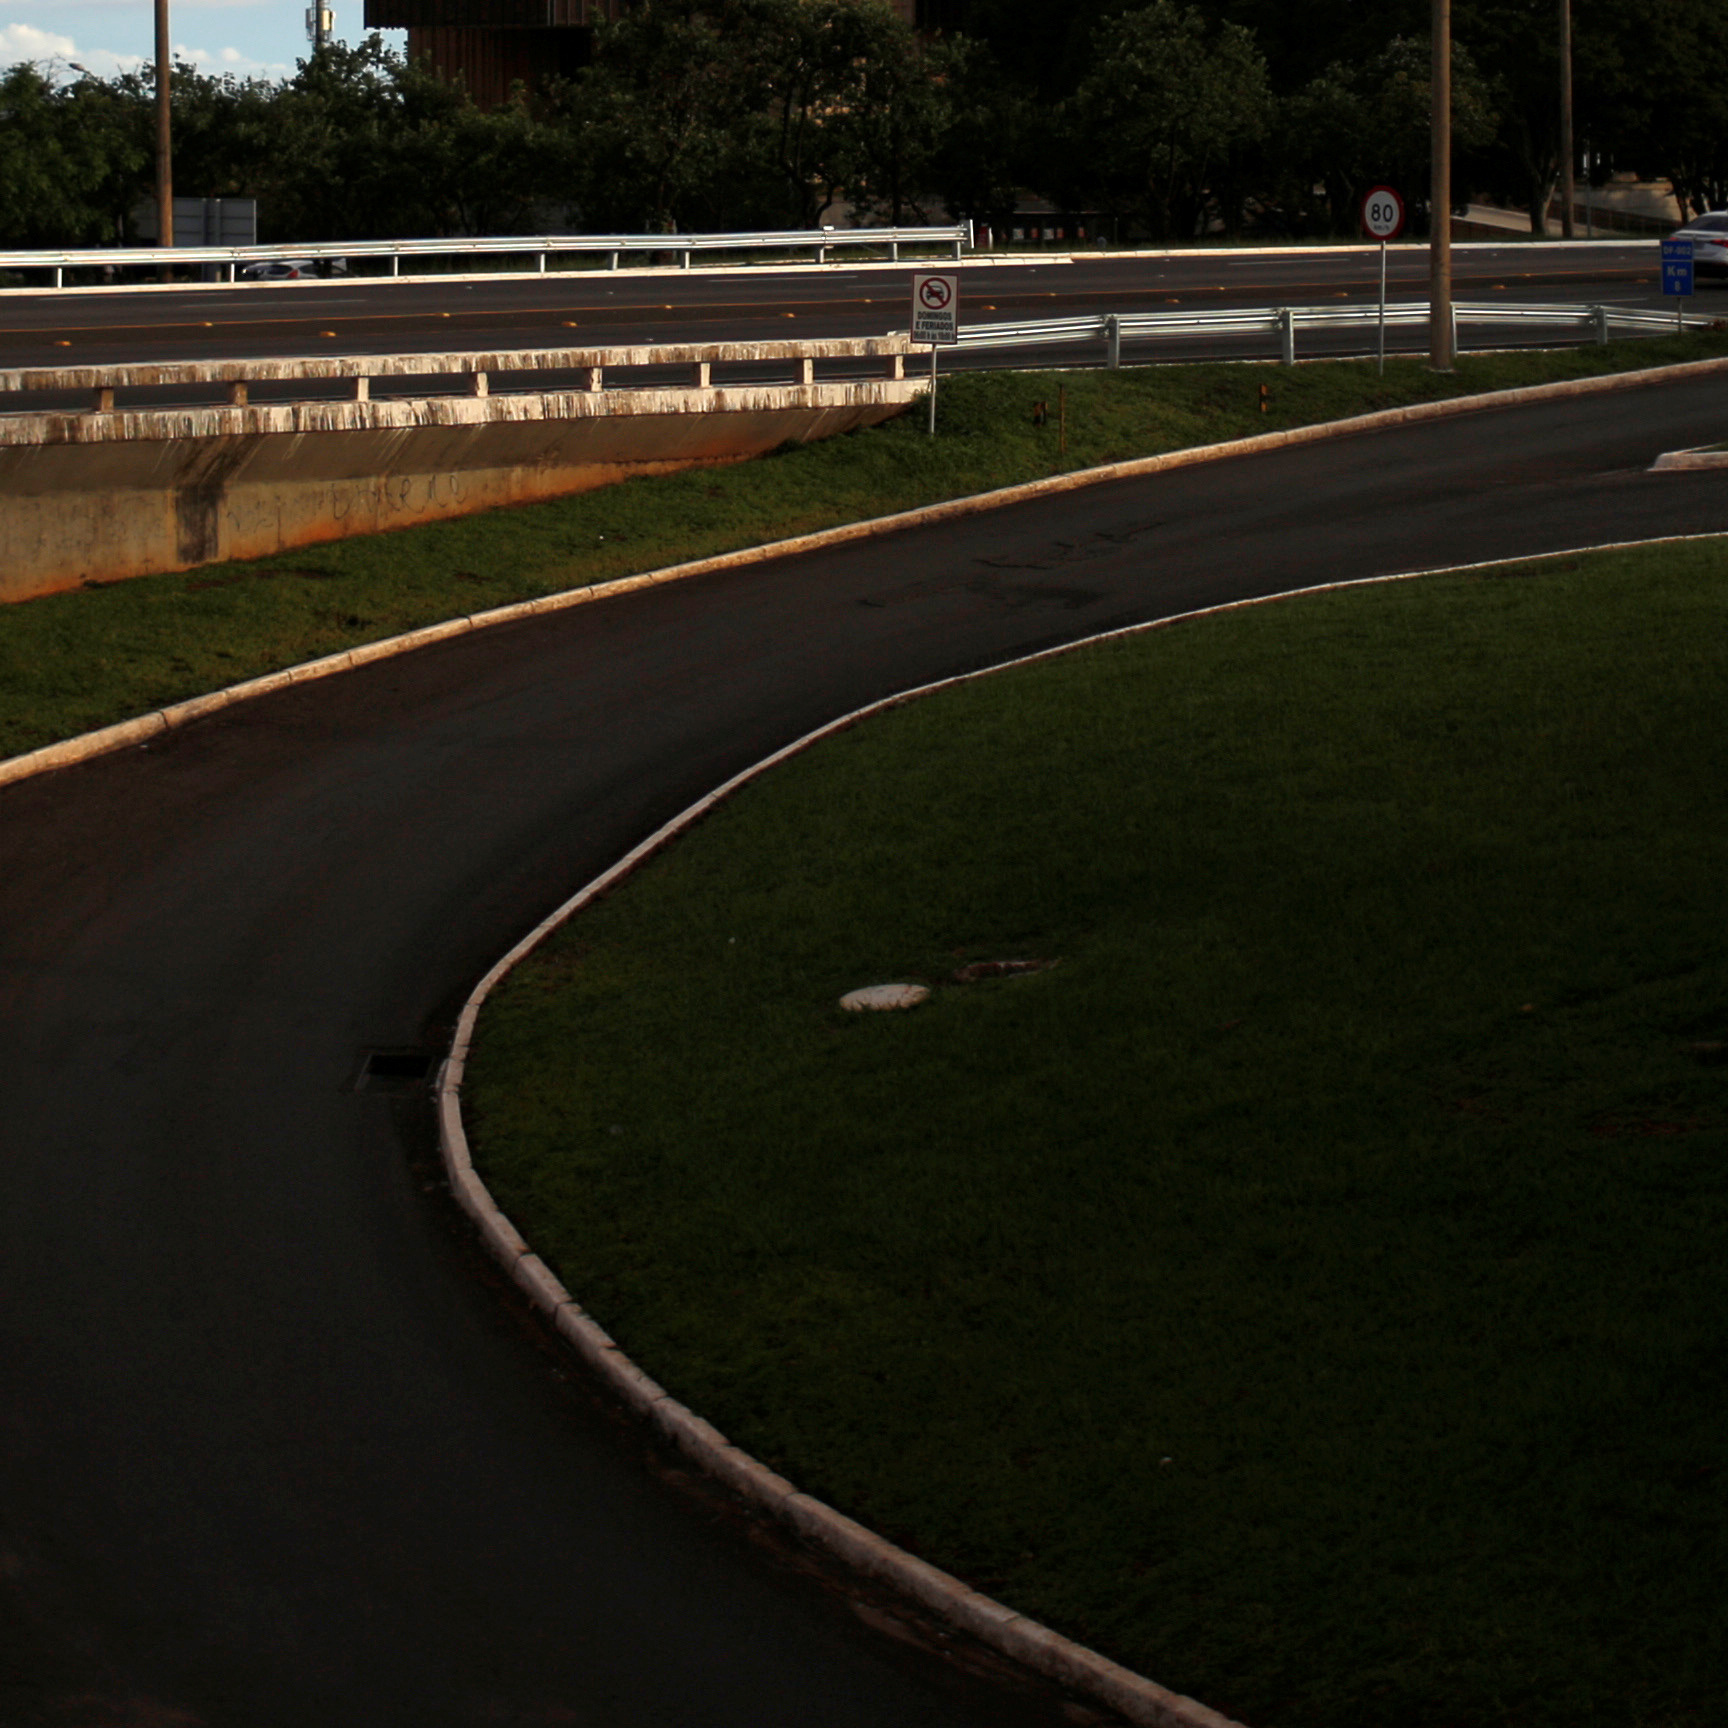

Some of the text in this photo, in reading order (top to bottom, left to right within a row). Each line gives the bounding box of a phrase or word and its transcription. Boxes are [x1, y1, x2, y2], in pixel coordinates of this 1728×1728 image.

[1371, 203, 1393, 223] 80
[1667, 265, 1687, 276] Km
[917, 311, 952, 321] DOMINGOS
[915, 321, 954, 331] E FERIADOS
